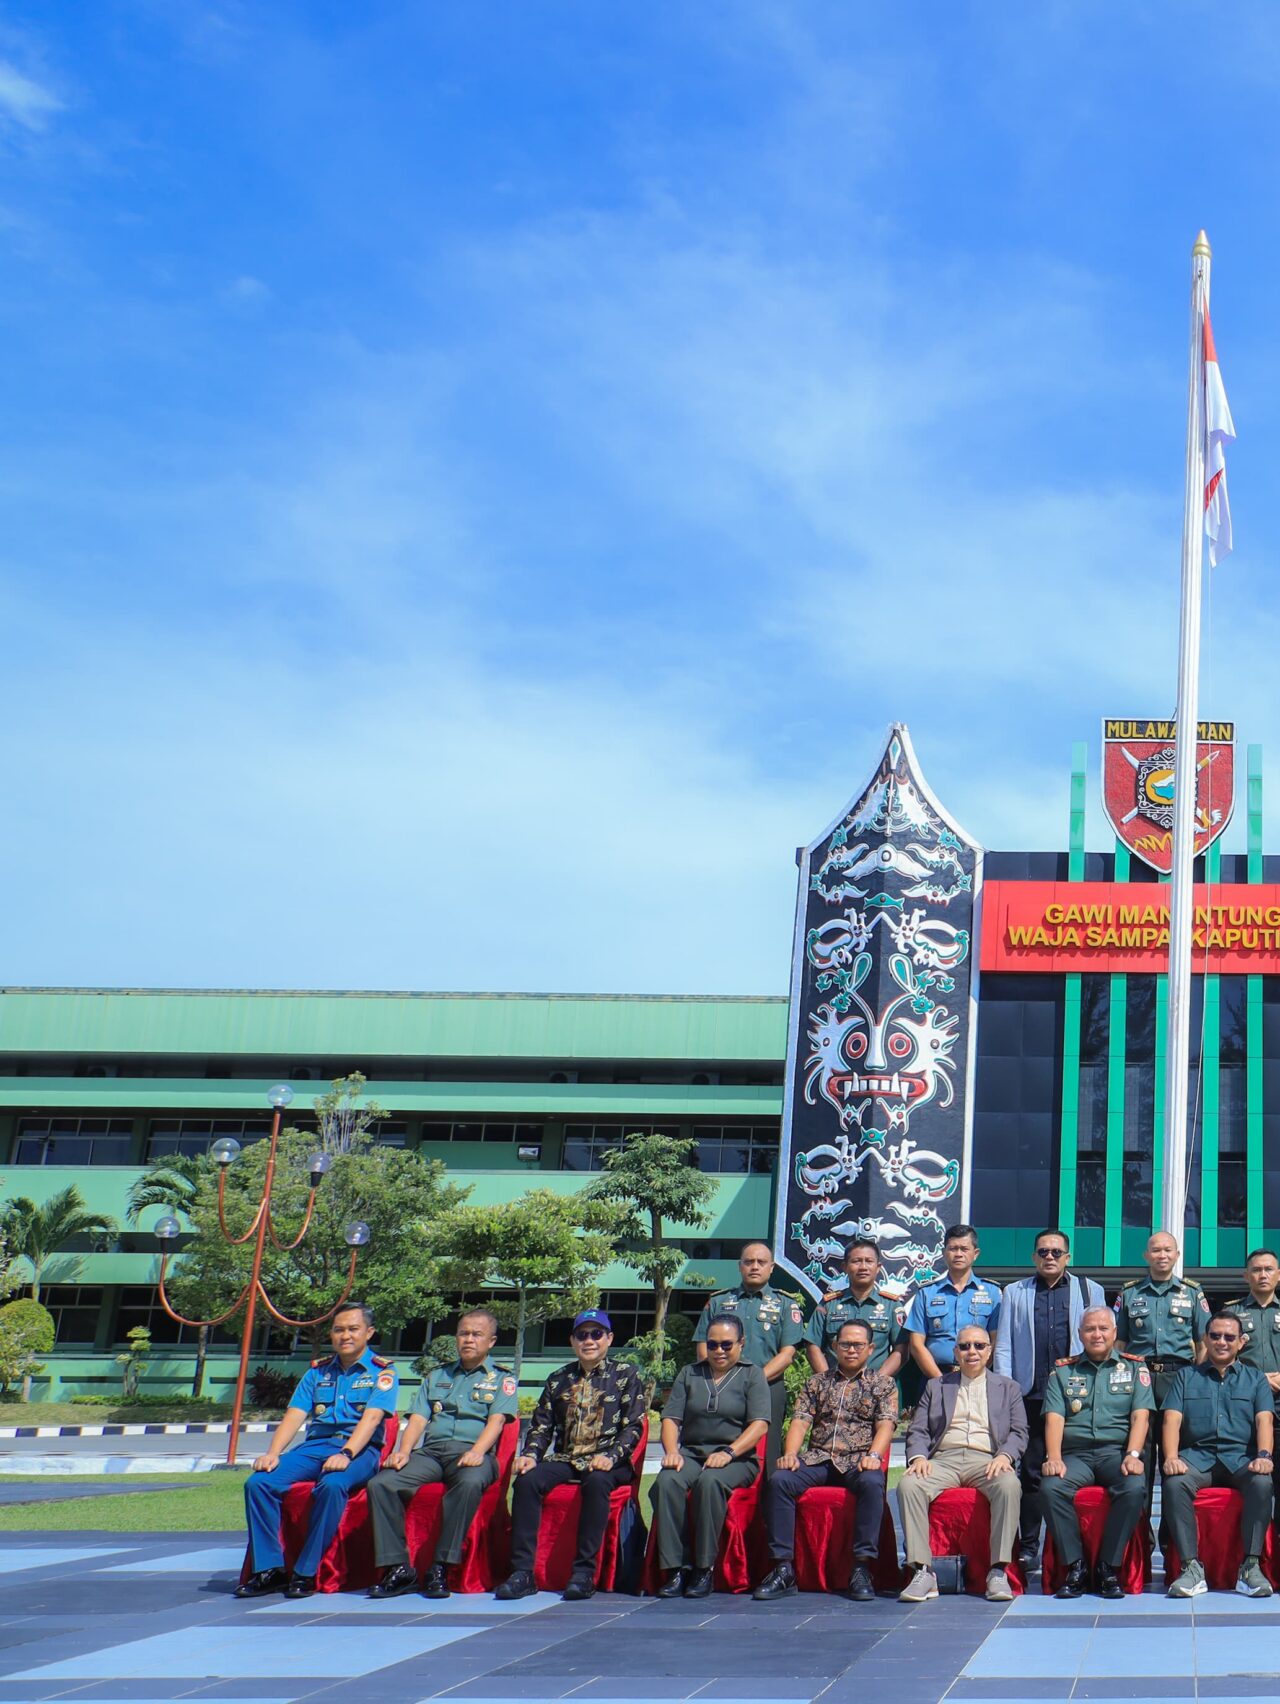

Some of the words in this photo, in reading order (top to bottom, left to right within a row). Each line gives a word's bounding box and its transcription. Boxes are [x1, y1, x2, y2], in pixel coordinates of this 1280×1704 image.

[1107, 721, 1231, 740] MULAWAMAN
[1045, 903, 1113, 924] GAWI
[1008, 926, 1081, 946] WAJA
[1086, 926, 1171, 948] SAMPA
